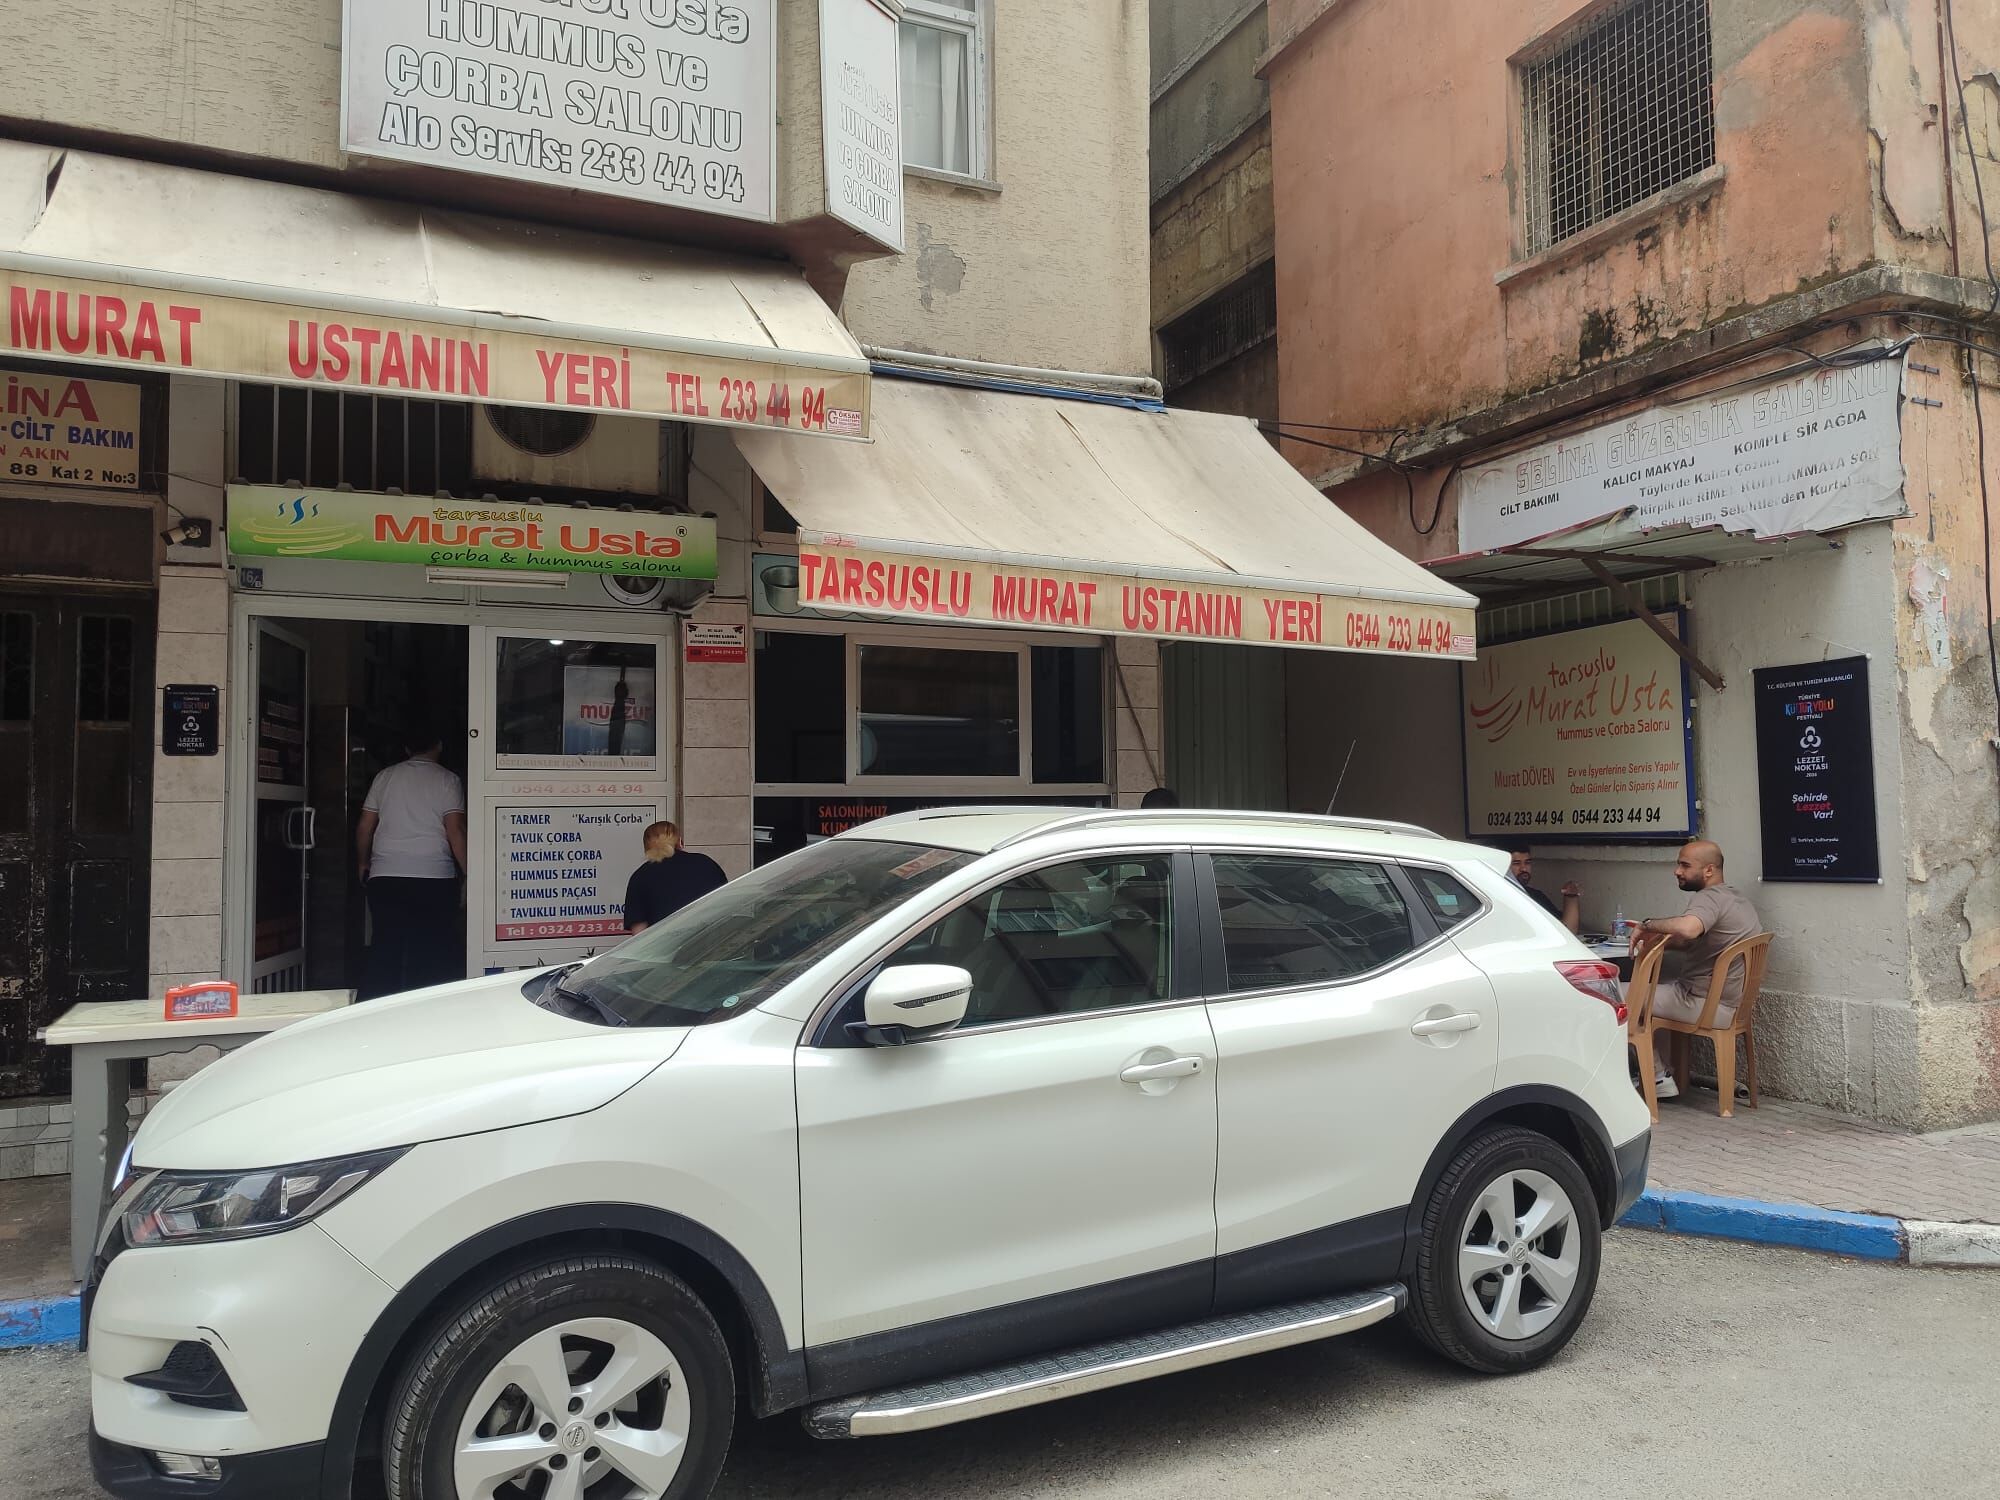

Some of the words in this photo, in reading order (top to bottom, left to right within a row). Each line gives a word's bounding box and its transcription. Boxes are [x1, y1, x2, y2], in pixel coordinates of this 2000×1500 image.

[428, 0, 645, 79] HUMMUS
[656, 49, 708, 91] ve
[384, 44, 553, 118] ÇORBA
[565, 80, 742, 152] SALONU
[839, 102, 893, 160] HUMMUS
[378, 102, 441, 150] Alo
[450, 115, 572, 174] Servis:
[581, 139, 645, 185] 233
[654, 152, 696, 195] 44
[704, 161, 744, 203] 94
[855, 147, 896, 197] ÇORBA
[843, 175, 891, 227] SALONU
[10, 286, 201, 366] MURAT
[288, 319, 489, 397] USTANIN
[536, 348, 631, 410] YERİ
[666, 371, 709, 416] TEL
[719, 376, 758, 423] 233
[766, 382, 791, 426] 44
[801, 386, 825, 430] 94
[1752, 359, 1889, 429] SALONU
[68, 426, 133, 449] BAKIM
[20, 446, 69, 461] AKIN
[10, 463, 38, 476] 88
[52, 466, 79, 480] Kat
[84, 469, 93, 480] 2
[102, 470, 136, 484] No:3
[1500, 501, 1521, 517] CİLT
[1524, 492, 1560, 511] BAKIMI
[1603, 470, 1641, 490] KALICI
[1645, 456, 1696, 479] MAKYAJ
[433, 507, 543, 523] tarsuslu
[374, 514, 545, 550] Murat
[559, 525, 681, 558] Usta
[430, 549, 490, 564] çorba
[499, 552, 517, 564] &
[526, 553, 614, 569] hummus
[621, 558, 682, 573] salonu
[800, 553, 972, 618] TARSUSLU
[992, 573, 1097, 627] MURAT
[1122, 585, 1242, 638] USTANIN
[1263, 593, 1322, 644] YERİ
[1346, 612, 1380, 648] 0544
[1387, 615, 1412, 652] 233
[1417, 617, 1433, 652] 44
[1435, 621, 1451, 654] 94
[1548, 646, 1616, 689] tarsuslu
[1526, 678, 1600, 726] Murat
[1609, 669, 1674, 716] Usta
[1557, 727, 1593, 741] Hummus
[1595, 726, 1606, 737] ve
[1608, 720, 1636, 739] Çorba
[1567, 767, 1577, 778] Ev
[1578, 767, 1587, 777] ve
[1628, 762, 1652, 774] Servis
[1654, 760, 1680, 775] Yapılır
[1795, 763, 1828, 772] NOKTASI
[1797, 756, 1825, 764] LEZZET
[1494, 770, 1521, 789] Murat
[1522, 766, 1555, 787] DÖVEN
[1570, 782, 1586, 794] Özel
[1587, 782, 1612, 794] Günler
[1613, 780, 1627, 795] İçin
[1628, 780, 1656, 794] Sipariş
[1656, 779, 1679, 791] Alınır
[597, 784, 617, 794] 44
[623, 784, 643, 793] 94
[1792, 793, 1828, 803] Şehirde
[510, 814, 551, 825] TARMER
[614, 813, 642, 827] Çorba
[818, 805, 888, 818] SALONUMUZ
[1487, 811, 1511, 827] 0324
[1514, 811, 1532, 826] 233
[1534, 810, 1548, 825] 44
[1550, 810, 1564, 825] 94
[1572, 809, 1599, 825] 0544
[1602, 808, 1624, 824] 233
[1627, 807, 1642, 823] 44
[1645, 807, 1661, 823] 94
[1813, 810, 1834, 819] Var!
[511, 833, 544, 844] TAVUK
[547, 832, 582, 845] ÇORBA
[510, 849, 565, 863] MERCİMEK
[567, 850, 602, 863] ÇORBA
[510, 869, 558, 881] HUMMUS
[561, 866, 597, 879] EZMESİ
[510, 888, 558, 900] HUMMUS
[561, 886, 597, 901] PAÇASI
[510, 907, 556, 919] TAVUKLU
[559, 904, 606, 917] HUMMUS
[506, 926, 524, 936] Tel
[538, 924, 573, 935] 0324
[578, 923, 602, 933] 233
[607, 922, 624, 931] 44
